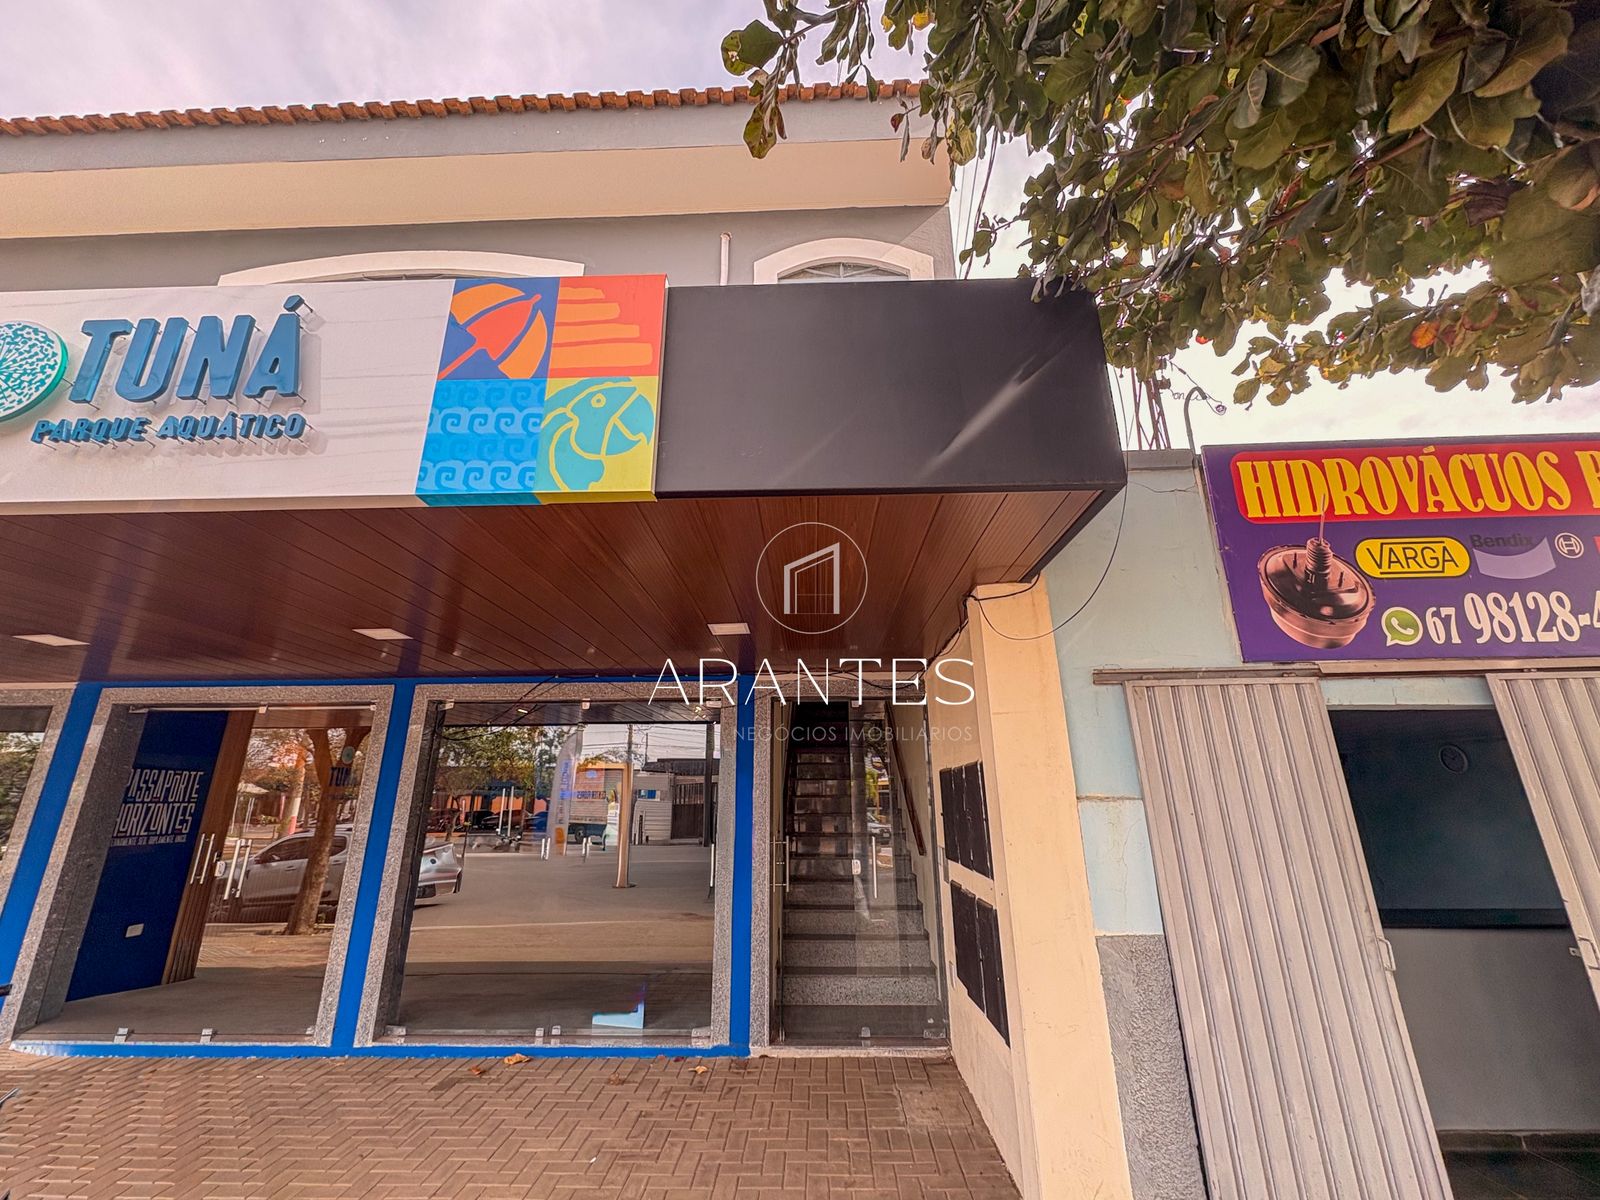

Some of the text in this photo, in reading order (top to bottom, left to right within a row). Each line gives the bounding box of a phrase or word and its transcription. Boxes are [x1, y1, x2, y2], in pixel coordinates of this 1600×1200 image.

[68, 294, 305, 404] TUNÁ
[30, 411, 306, 444] PARQUE AQUÁTICO
[1236, 446, 1572, 519] HIDROVÁCUOS
[1365, 541, 1460, 575] VARGA
[1470, 533, 1533, 548] Bendix
[1425, 606, 1462, 645] 67
